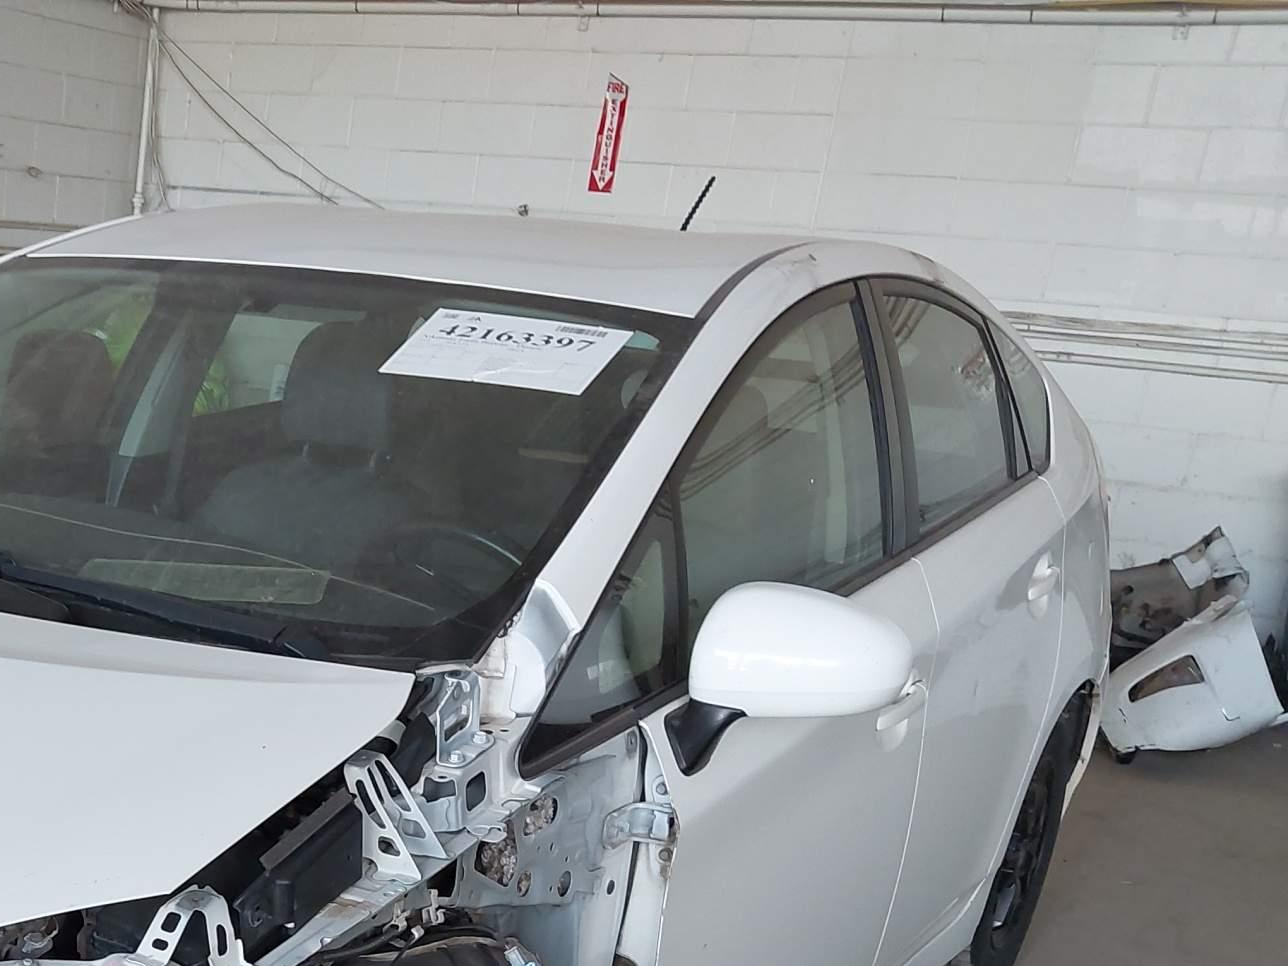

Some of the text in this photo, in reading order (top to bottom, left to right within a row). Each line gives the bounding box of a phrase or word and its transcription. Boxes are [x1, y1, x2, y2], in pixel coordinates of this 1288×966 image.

[607, 81, 625, 94] FIRE
[598, 98, 618, 183] EXTINGUISHER
[439, 323, 596, 352] 42163397
